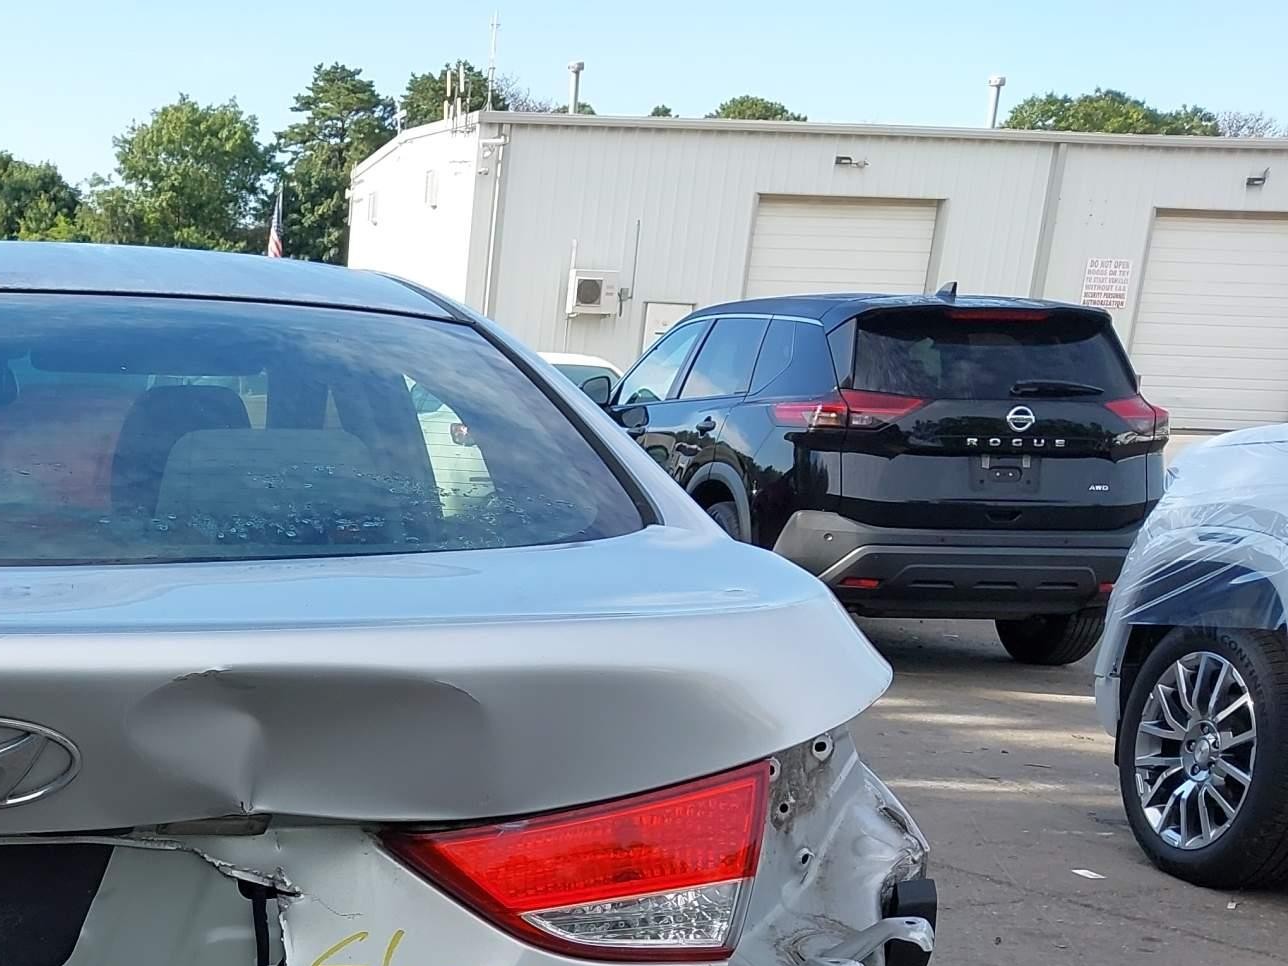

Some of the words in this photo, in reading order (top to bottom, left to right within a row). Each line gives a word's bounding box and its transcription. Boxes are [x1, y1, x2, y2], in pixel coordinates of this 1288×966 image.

[1090, 260, 1099, 268] DO
[1100, 260, 1112, 269] NOT
[966, 437, 1066, 447] ROGUE
